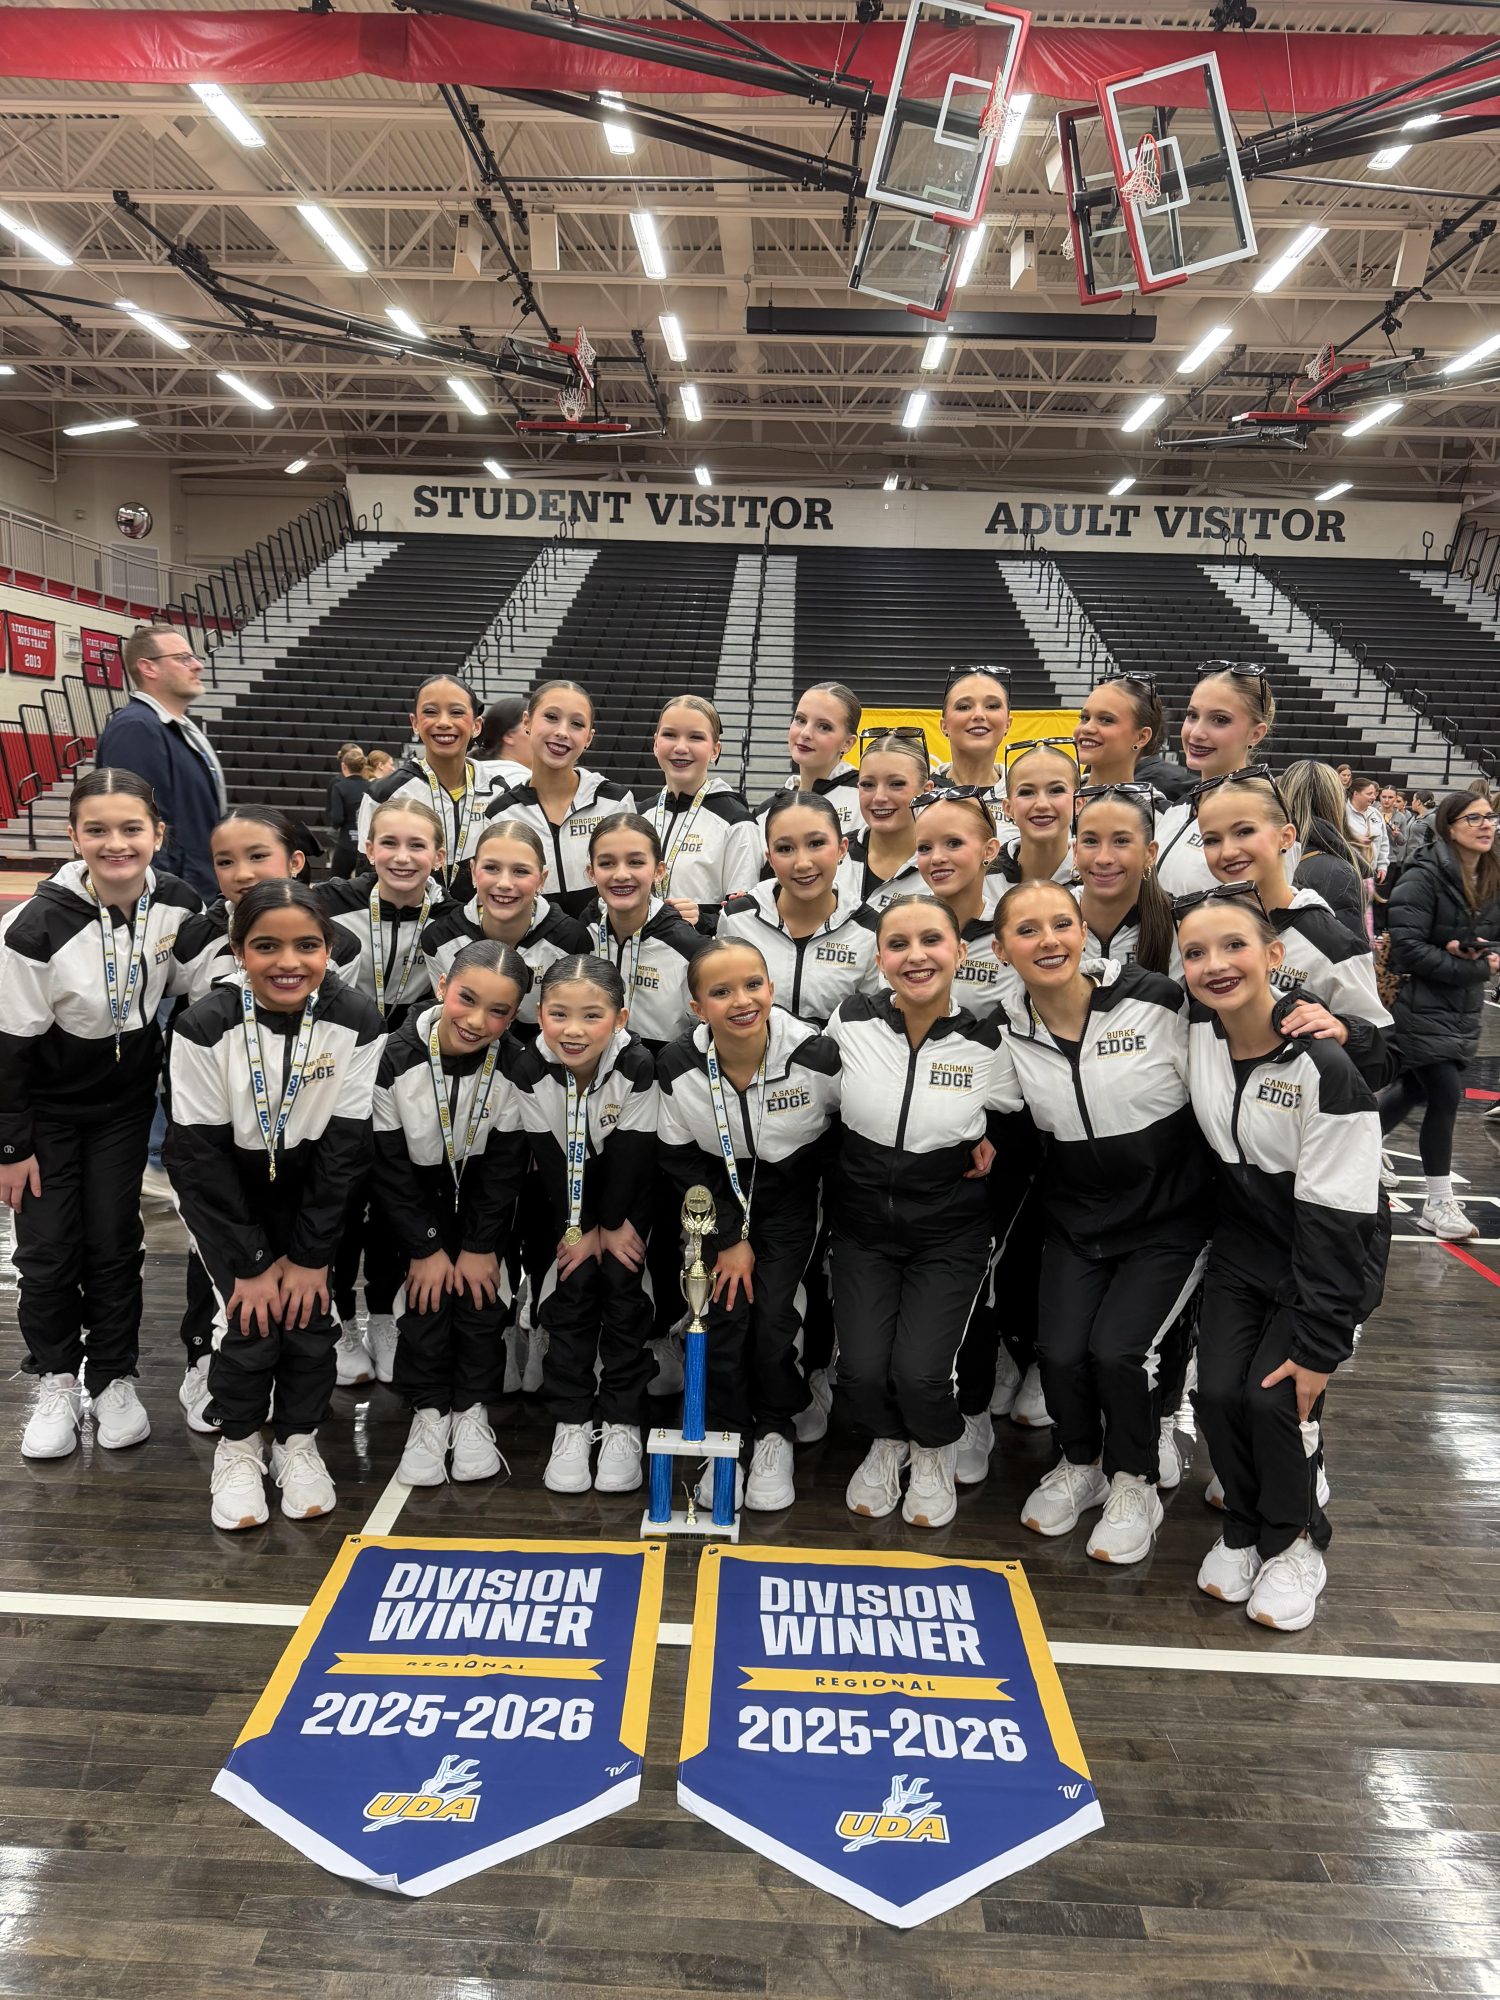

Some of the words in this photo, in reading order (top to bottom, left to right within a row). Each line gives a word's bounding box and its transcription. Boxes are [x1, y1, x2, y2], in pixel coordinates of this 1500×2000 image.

[413, 485, 631, 524] STUDENT
[645, 493, 834, 531] VISITOR
[985, 502, 1141, 537] ADULT
[1154, 506, 1346, 543] VISITOR
[28, 626, 51, 639] FINALIST
[24, 653, 42, 668] 2013
[570, 824, 596, 836] EDG
[681, 842, 702, 852] DGE
[816, 947, 858, 964] EDGE
[826, 942, 850, 950] BOYCE
[130, 964, 138, 984] UCA
[636, 976, 660, 989] DGE
[954, 966, 998, 984] EDGE
[122, 1000, 130, 1020] UCA
[244, 990, 252, 1012] UCA
[430, 1034, 438, 1056] UDA
[1106, 1028, 1136, 1040] BURKE
[1096, 1035, 1146, 1056] EDGE
[709, 1058, 718, 1080] UCA
[930, 1070, 972, 1088] EDGE
[932, 1062, 974, 1074] BACHMAN
[254, 1070, 264, 1094] UCA
[286, 1074, 299, 1096] UCA
[772, 1086, 804, 1098] A.SASKI
[766, 1092, 810, 1112] EDGE
[259, 1110, 269, 1134] UCA
[276, 1113, 287, 1136] UCA
[440, 1106, 450, 1128] UDA
[576, 1142, 584, 1164] UCA
[722, 1135, 732, 1157] UCA
[574, 1180, 582, 1200] UCA
[731, 1172, 740, 1194] UCA
[381, 1562, 602, 1604] DIVISION
[760, 1576, 976, 1620] DIVISION
[368, 1602, 593, 1646] WINNER
[760, 1614, 986, 1666] WINNER
[816, 1676, 936, 1691] REGIONAL
[301, 1692, 594, 1741] 2025-2026
[738, 1706, 1028, 1762] 2025-2026
[366, 1794, 479, 1820] UDA
[838, 1814, 947, 1840] UDA
